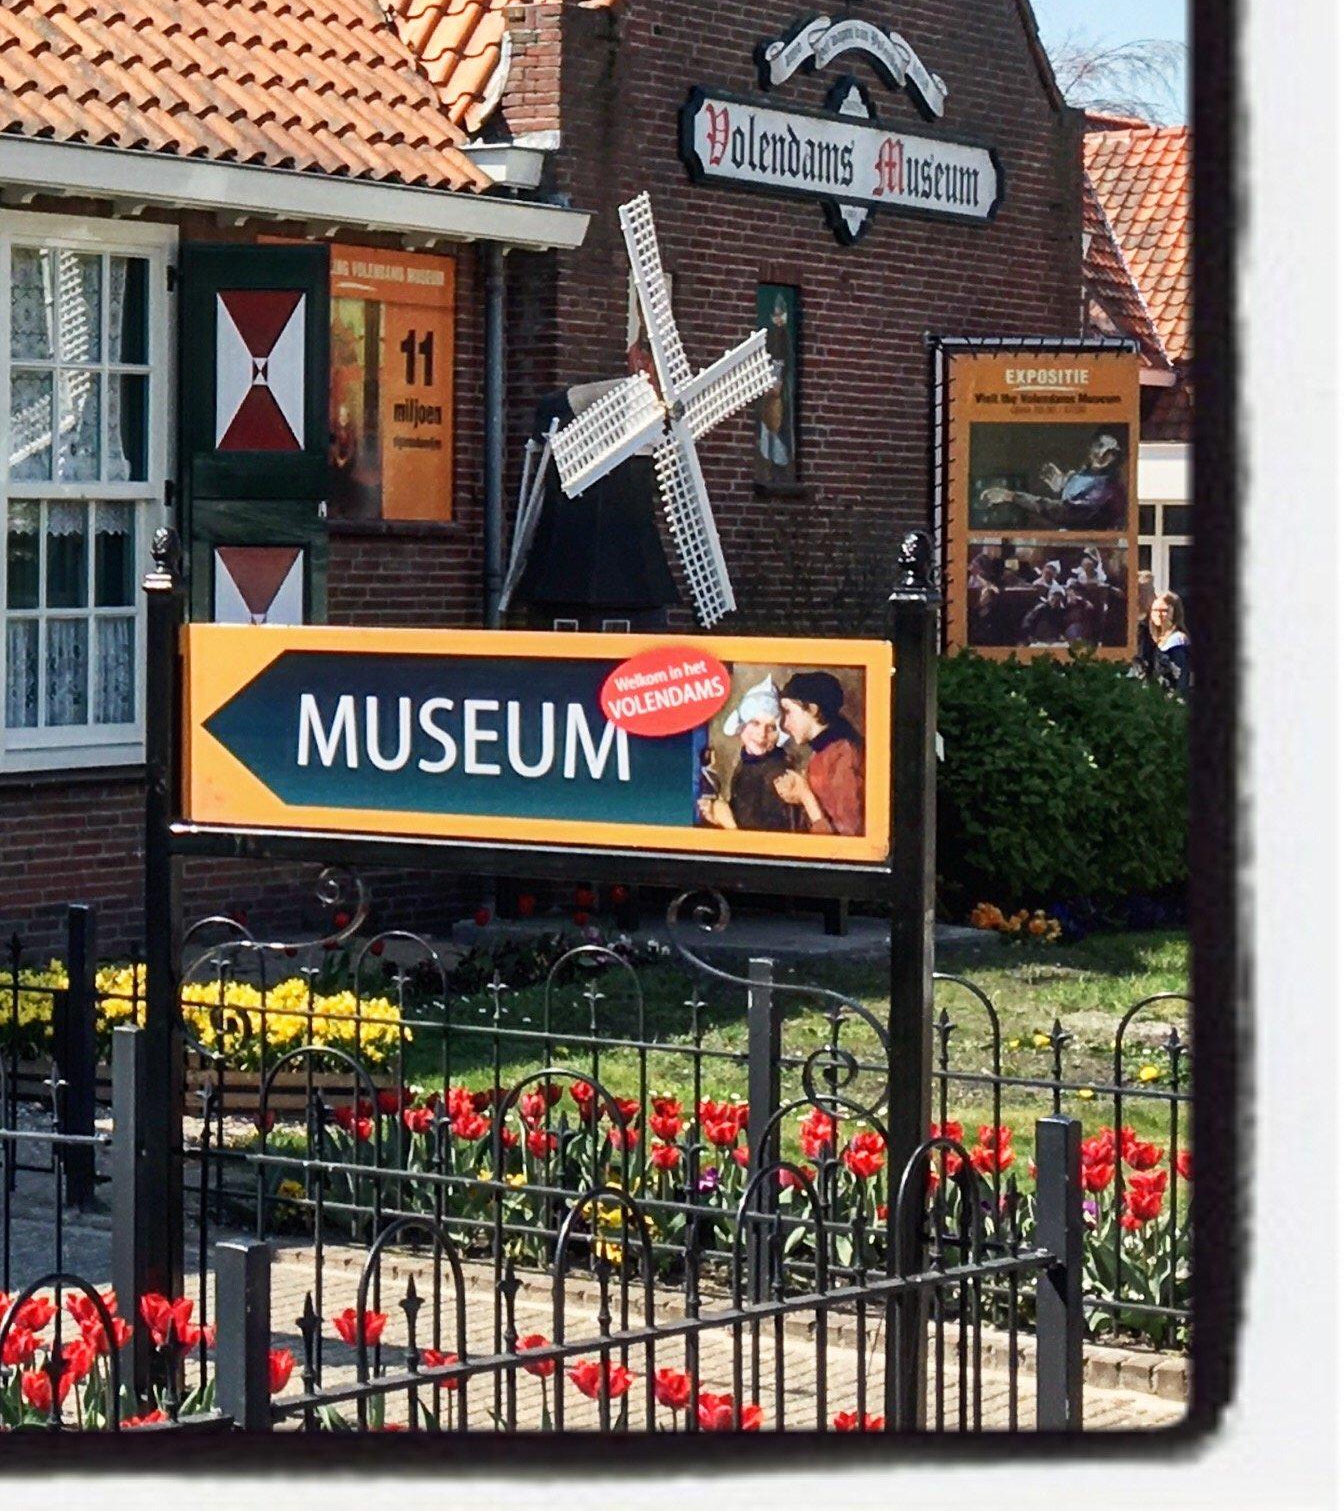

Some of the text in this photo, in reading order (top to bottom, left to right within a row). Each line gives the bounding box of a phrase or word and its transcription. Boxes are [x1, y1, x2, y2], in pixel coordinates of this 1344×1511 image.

[705, 103, 979, 207] Volendams Museum
[400, 329, 433, 387] 11
[1005, 368, 1090, 385] EXPOSITIE
[393, 398, 442, 428] miljoen
[607, 675, 725, 720] VOLENDAMS
[614, 660, 708, 693] Welkom in het
[297, 693, 632, 781] MUSEUM
